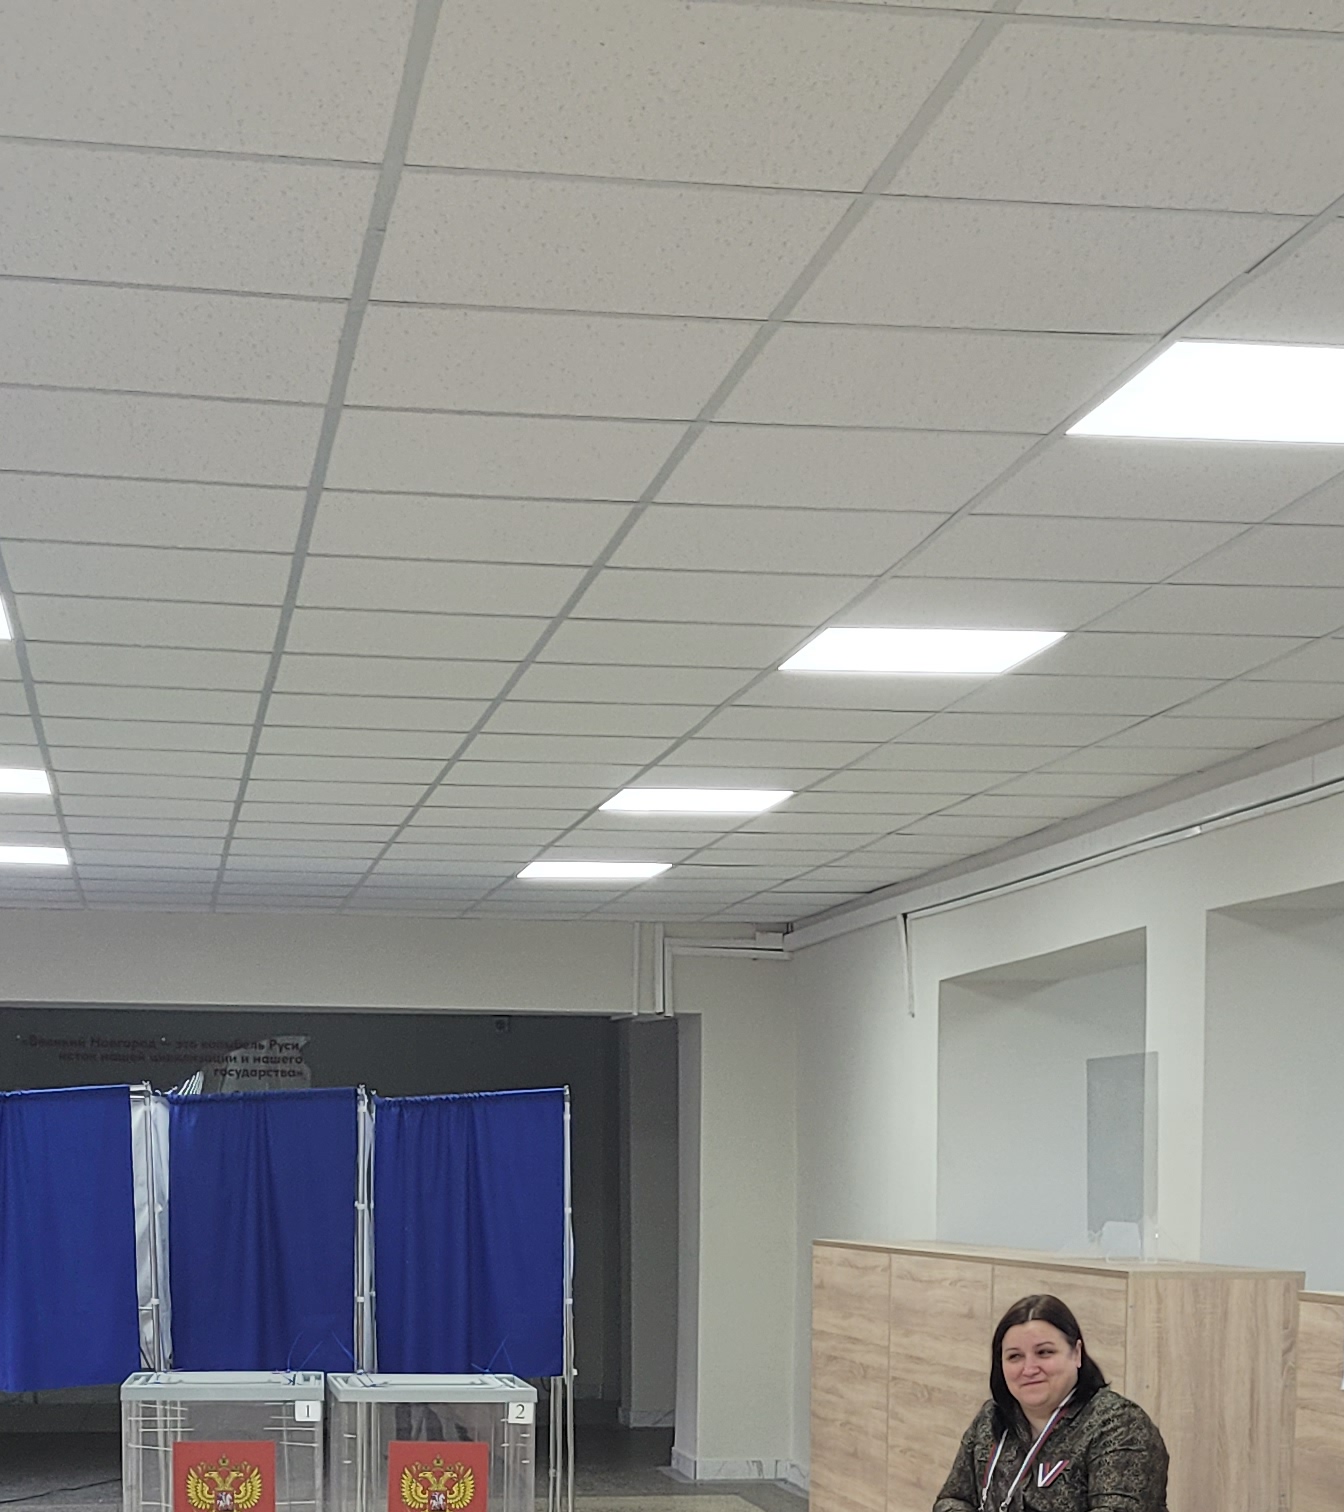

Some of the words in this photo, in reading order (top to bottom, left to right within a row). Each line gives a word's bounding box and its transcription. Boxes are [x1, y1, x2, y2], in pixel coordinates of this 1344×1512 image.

[241, 1055, 249, 1063] и
[253, 1055, 304, 1065] нашего
[515, 1403, 525, 1419] 2
